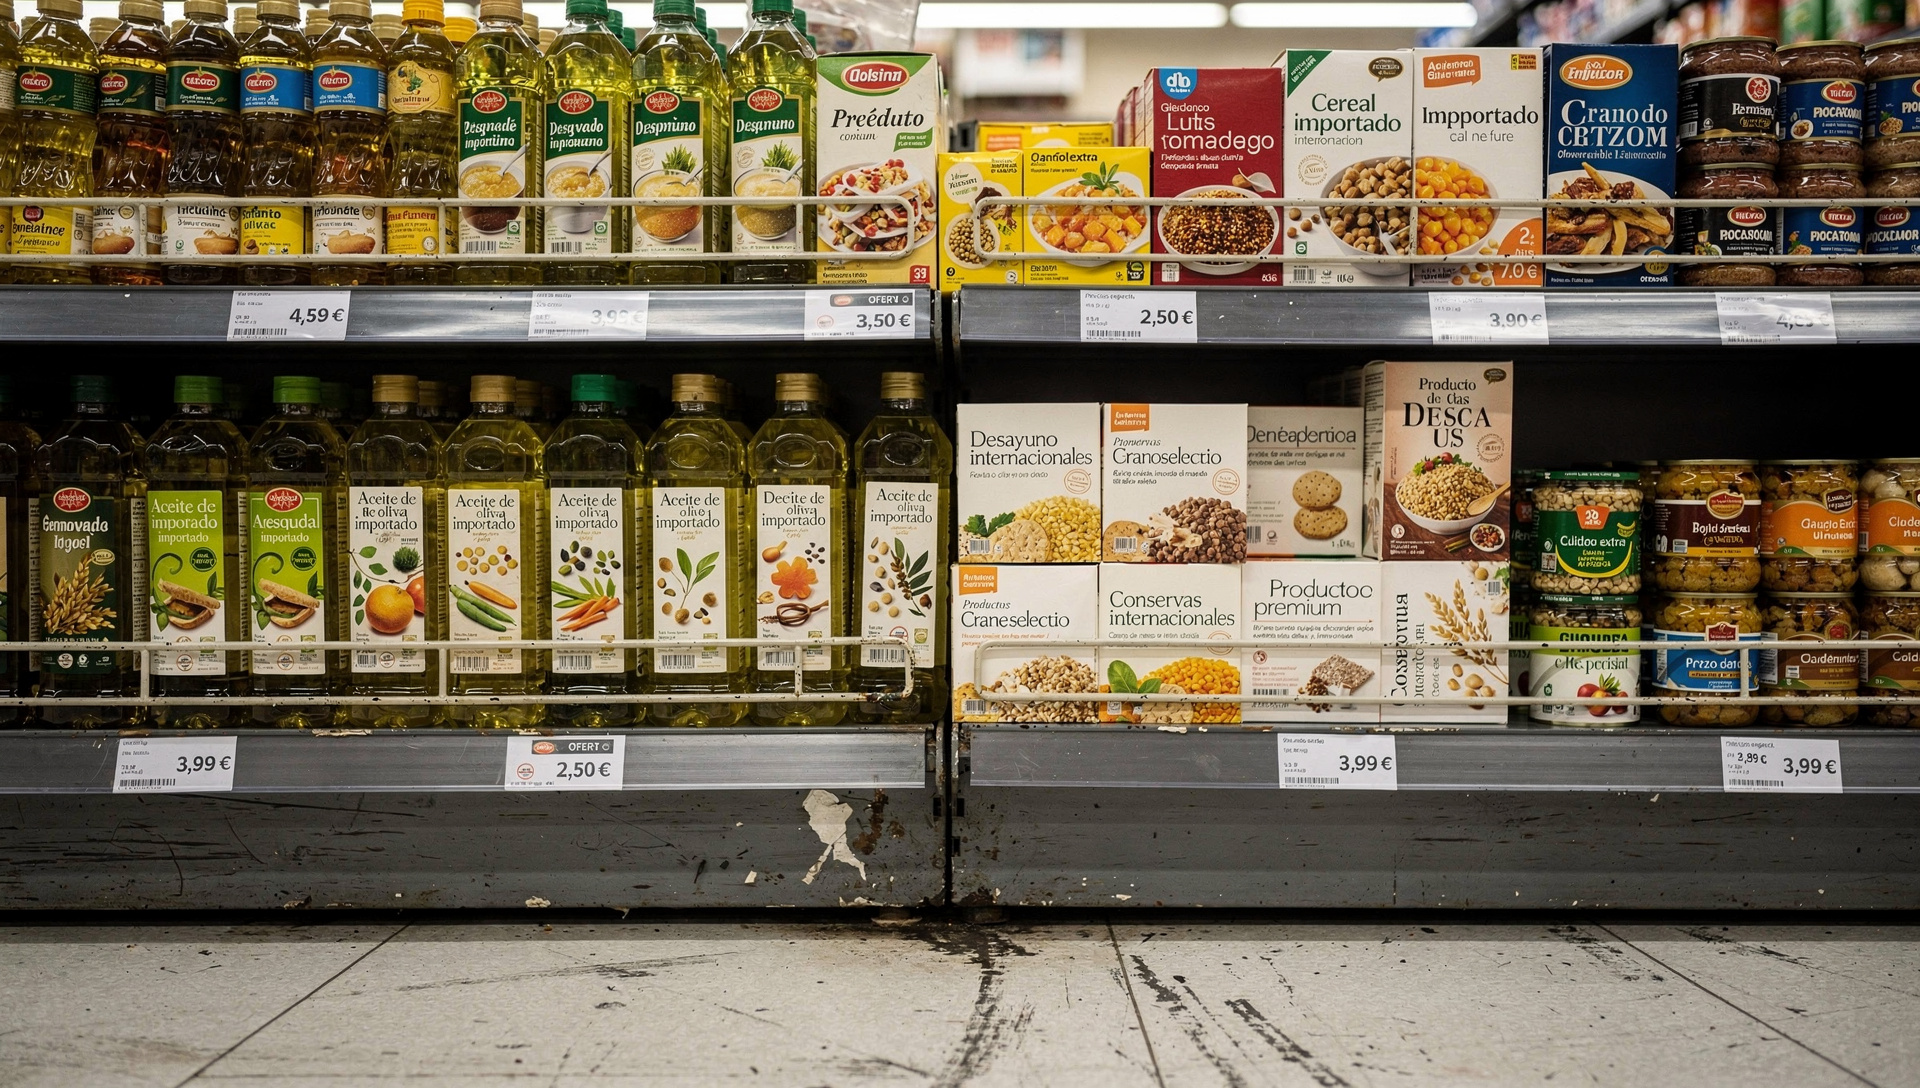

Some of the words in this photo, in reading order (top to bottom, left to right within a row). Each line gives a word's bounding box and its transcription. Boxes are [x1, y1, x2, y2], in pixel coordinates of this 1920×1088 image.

[1311, 93, 1376, 112] Cereal
[1294, 112, 1402, 136] importado
[1449, 130, 1468, 142] cal
[1471, 132, 1487, 142] ne
[1490, 129, 1514, 142] fure
[1527, 263, 1538, 279] €
[289, 308, 329, 326] 4,59
[331, 308, 345, 322] €
[856, 313, 896, 330] 3,50
[899, 313, 911, 327] €
[1140, 309, 1179, 327] 2,50
[1181, 310, 1194, 324] €
[1489, 312, 1528, 329] 3,90
[1529, 313, 1542, 327] €
[1419, 378, 1477, 391] Producto
[1402, 402, 1492, 428] DESCA
[970, 430, 1058, 451] Desayuno
[970, 447, 1093, 465] internacionales
[151, 498, 194, 513] Aceite
[358, 492, 398, 505] Aceite
[400, 492, 417, 505] de
[499, 495, 515, 508] de
[558, 493, 600, 507] Aceite
[602, 493, 617, 507] de
[660, 493, 701, 507] Aceite
[704, 493, 720, 507] de
[810, 491, 825, 504] de
[152, 514, 218, 531] imporado
[355, 515, 418, 533] importado
[453, 517, 516, 533] importado
[555, 515, 618, 532] importado
[656, 515, 720, 532] importado
[762, 513, 826, 529] importado
[871, 510, 932, 526] importado
[158, 531, 209, 545] importado
[260, 532, 309, 543] importado
[1109, 590, 1202, 608] Conservas
[1109, 607, 1235, 626] internacionales
[1254, 599, 1342, 621] premium
[176, 756, 216, 775] 3,99
[219, 756, 232, 771] €
[556, 762, 596, 780] 2,50
[598, 762, 611, 777] €
[1339, 755, 1378, 774] 3,99
[1381, 756, 1392, 771] €
[1783, 757, 1822, 777] 3,99
[1825, 759, 1837, 774] €
